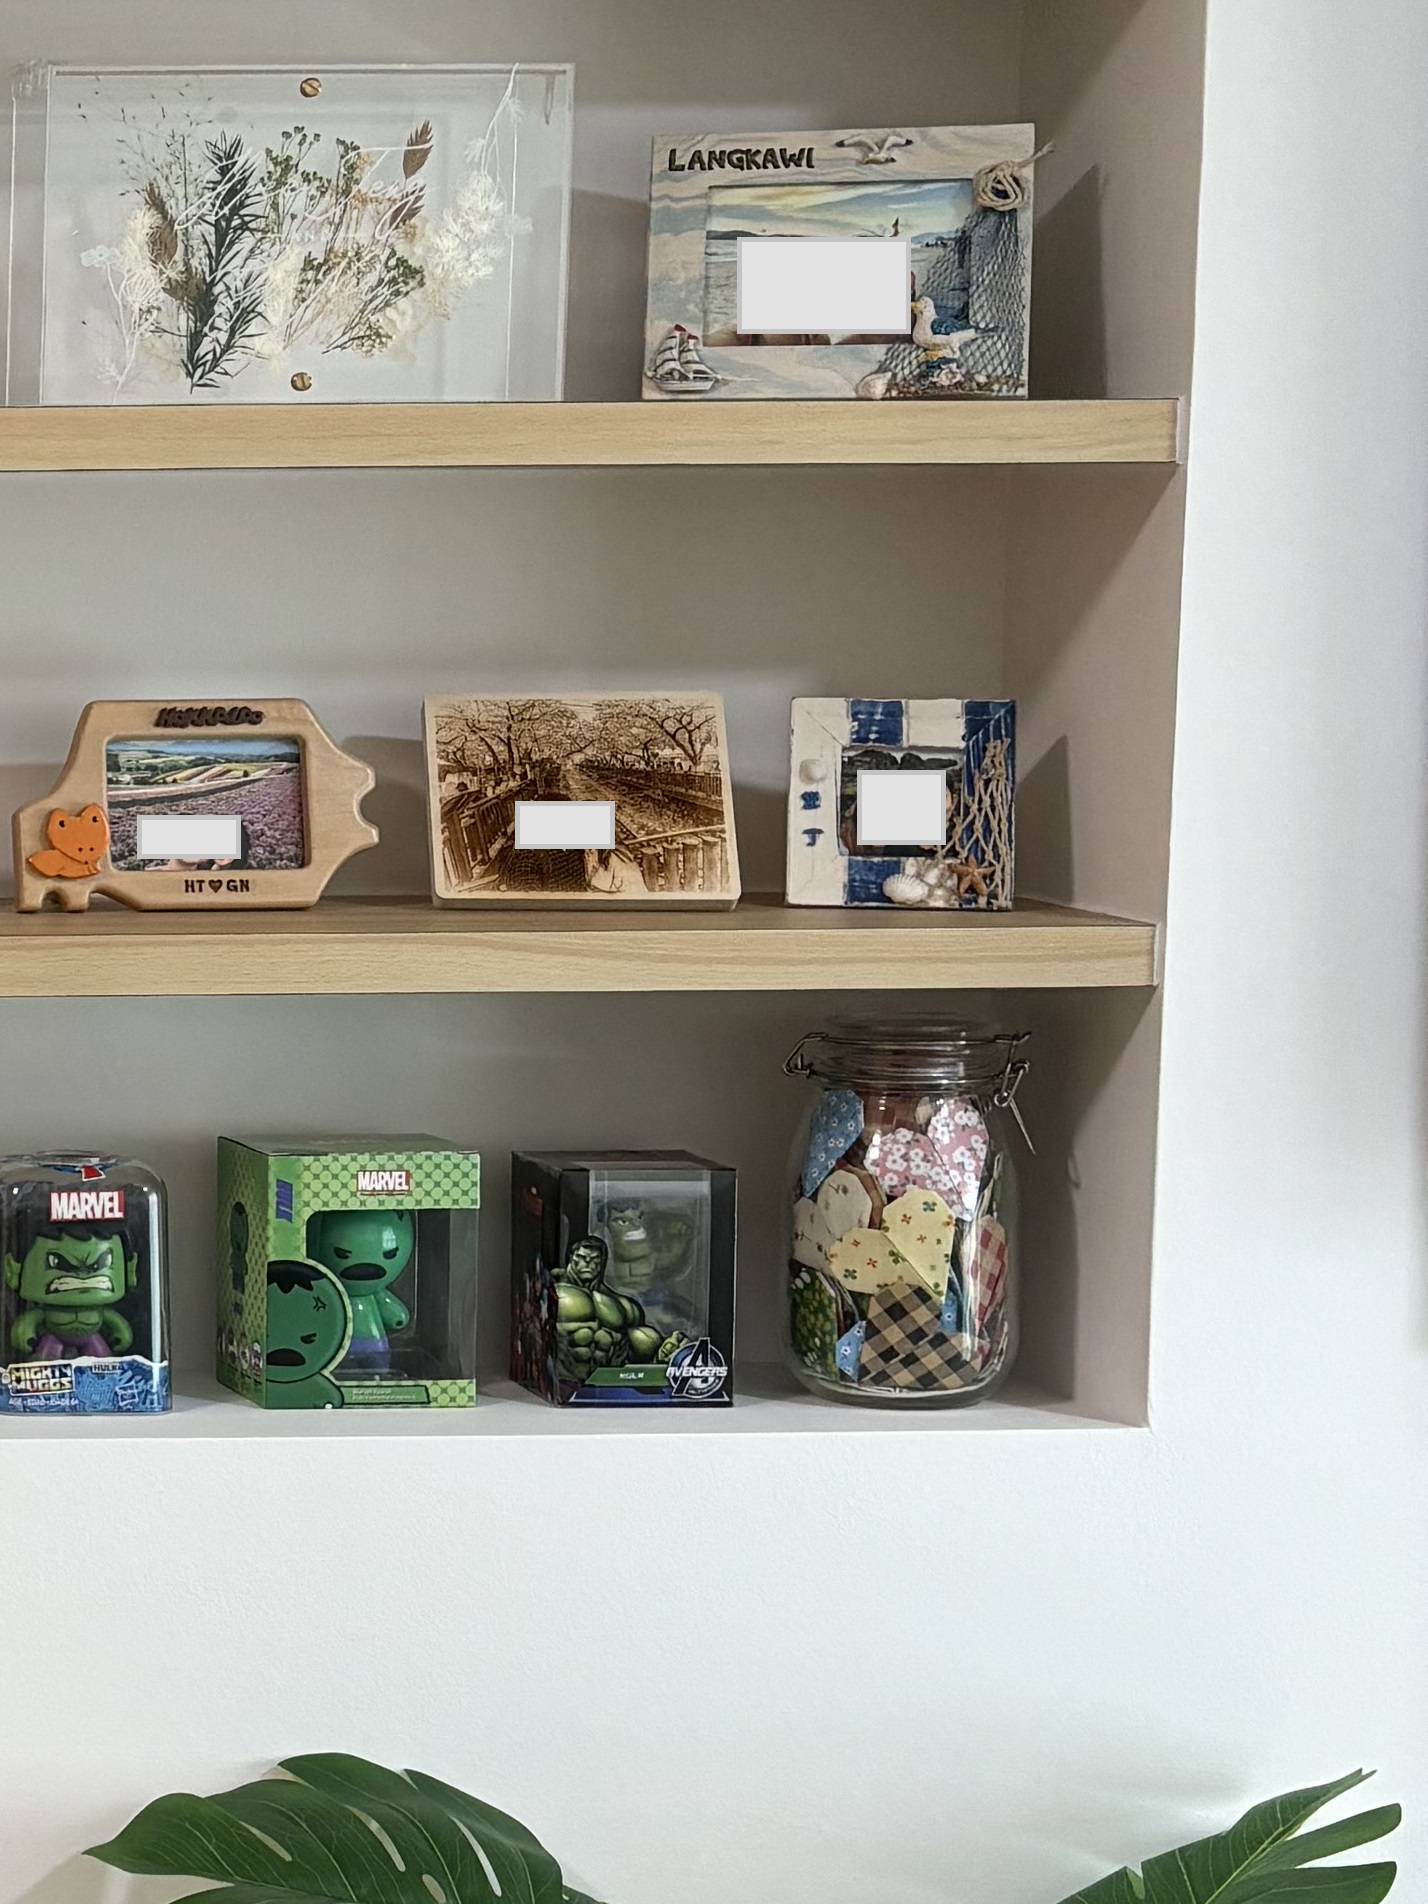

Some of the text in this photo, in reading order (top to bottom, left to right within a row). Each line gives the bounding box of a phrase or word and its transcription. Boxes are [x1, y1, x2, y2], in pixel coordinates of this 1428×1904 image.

[668, 147, 815, 172] LANGKAWI
[184, 879, 250, 893] HT GN
[357, 1171, 409, 1191] MARVEL
[50, 1191, 124, 1220] MARVEL
[11, 1366, 72, 1380] MIGHTY
[666, 1366, 728, 1377] AVENGERS
[12, 1377, 72, 1393] MUGGS
